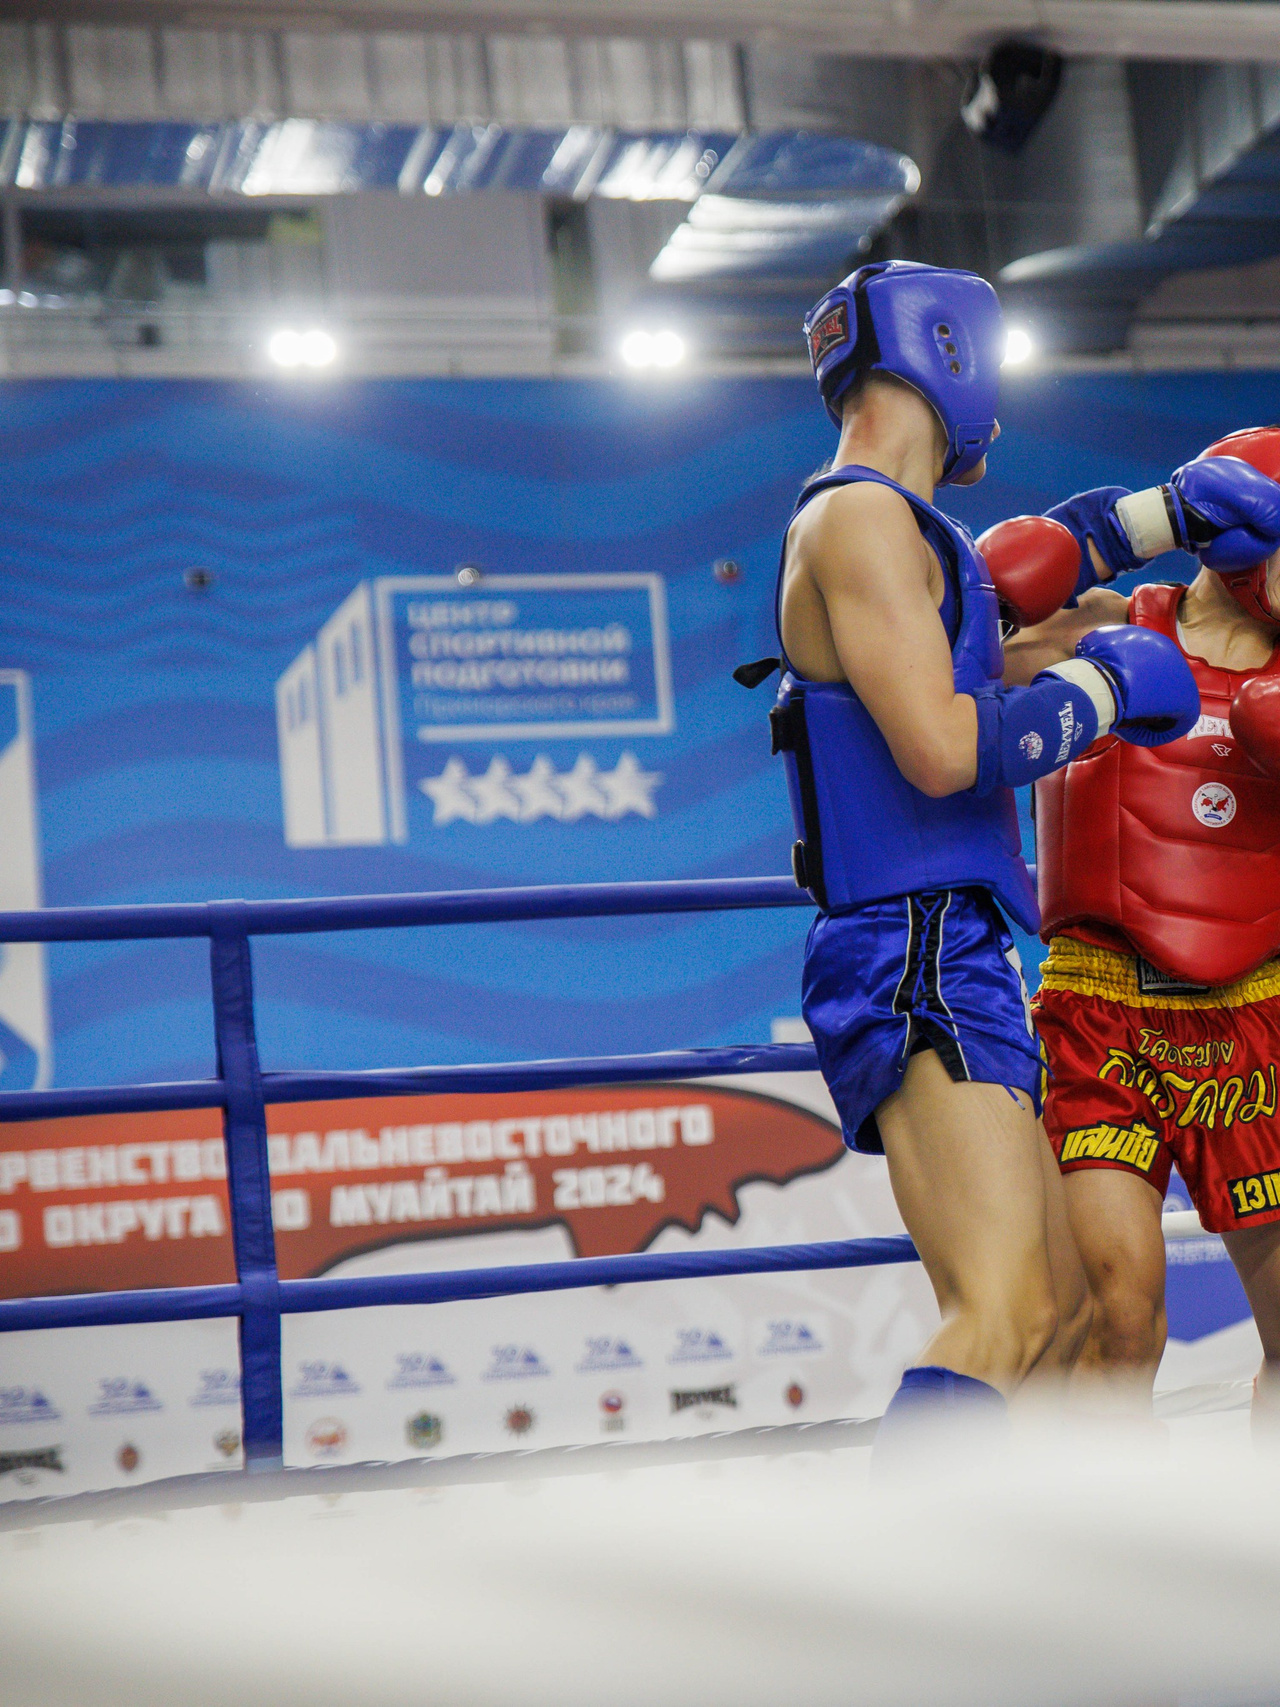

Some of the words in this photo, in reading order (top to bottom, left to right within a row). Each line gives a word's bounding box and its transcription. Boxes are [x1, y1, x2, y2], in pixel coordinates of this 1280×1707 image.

[408, 601, 517, 629] ЦЕНТР
[409, 623, 631, 658] СПОРТИВНОЙ
[411, 660, 628, 689] ПОДГОТОВКИ
[43, 1195, 224, 1249] ОКРУГА
[271, 1188, 311, 1231] О
[330, 1161, 537, 1228] МУАЙТАЙ
[552, 1163, 665, 1210] 2024
